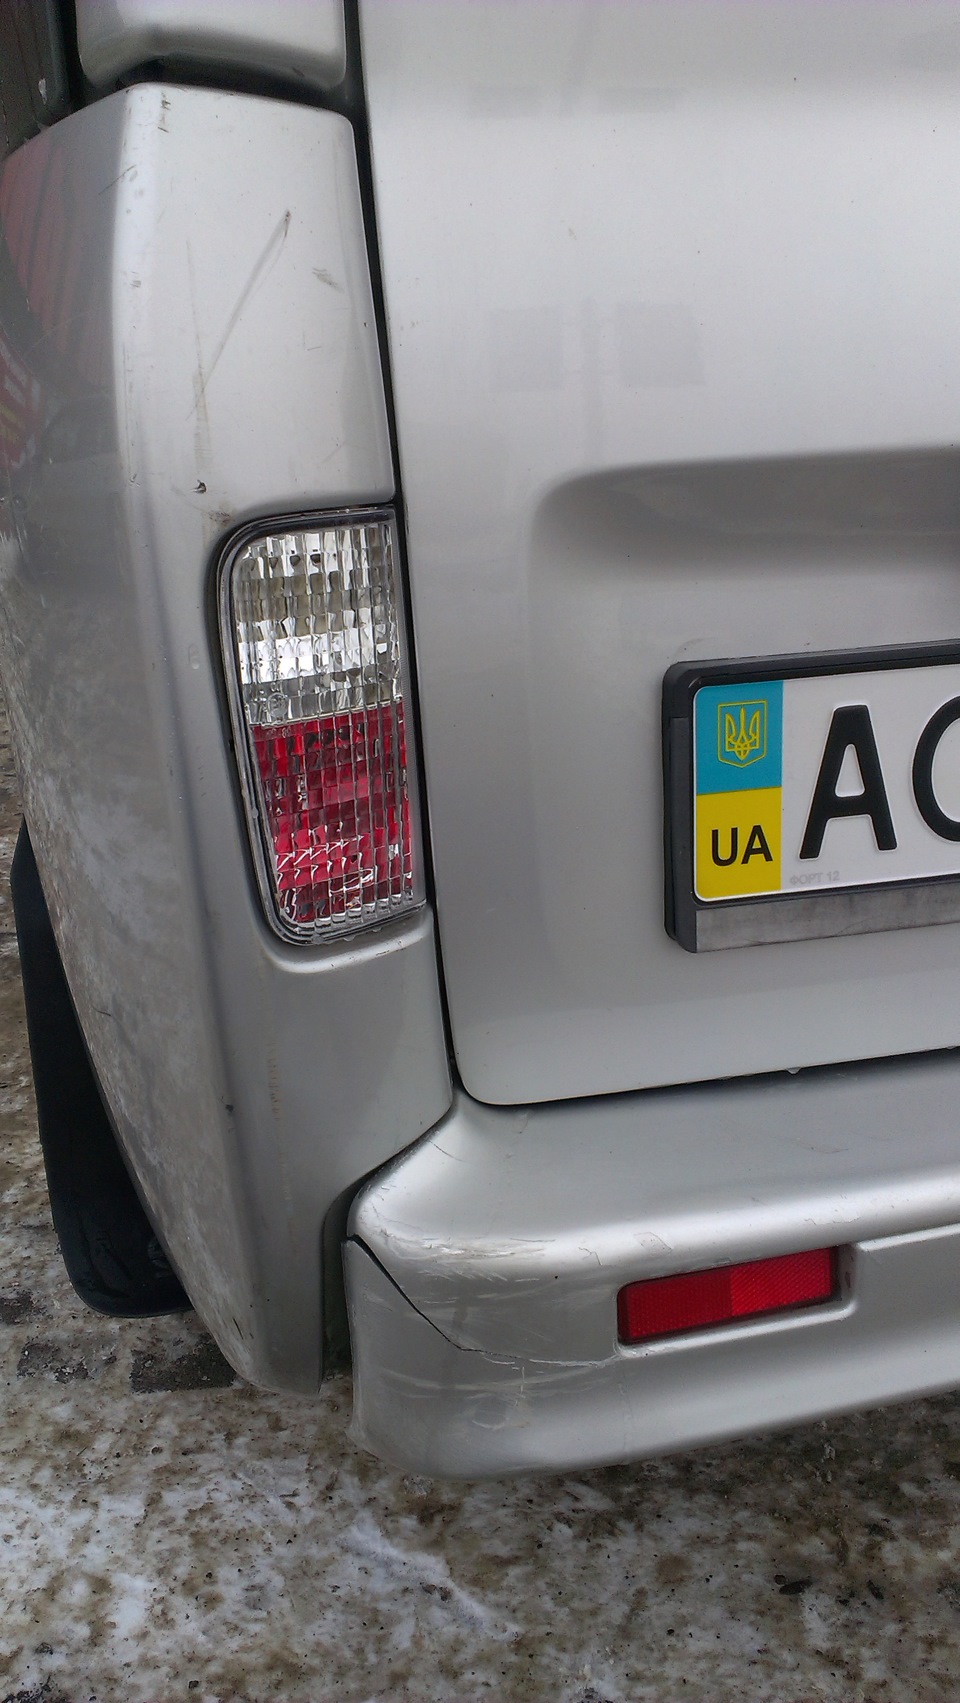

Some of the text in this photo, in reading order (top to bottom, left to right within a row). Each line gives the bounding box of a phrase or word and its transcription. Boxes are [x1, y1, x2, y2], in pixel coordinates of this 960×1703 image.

[711, 825, 773, 867] UA
[789, 870, 840, 886] ФОРТ 12
